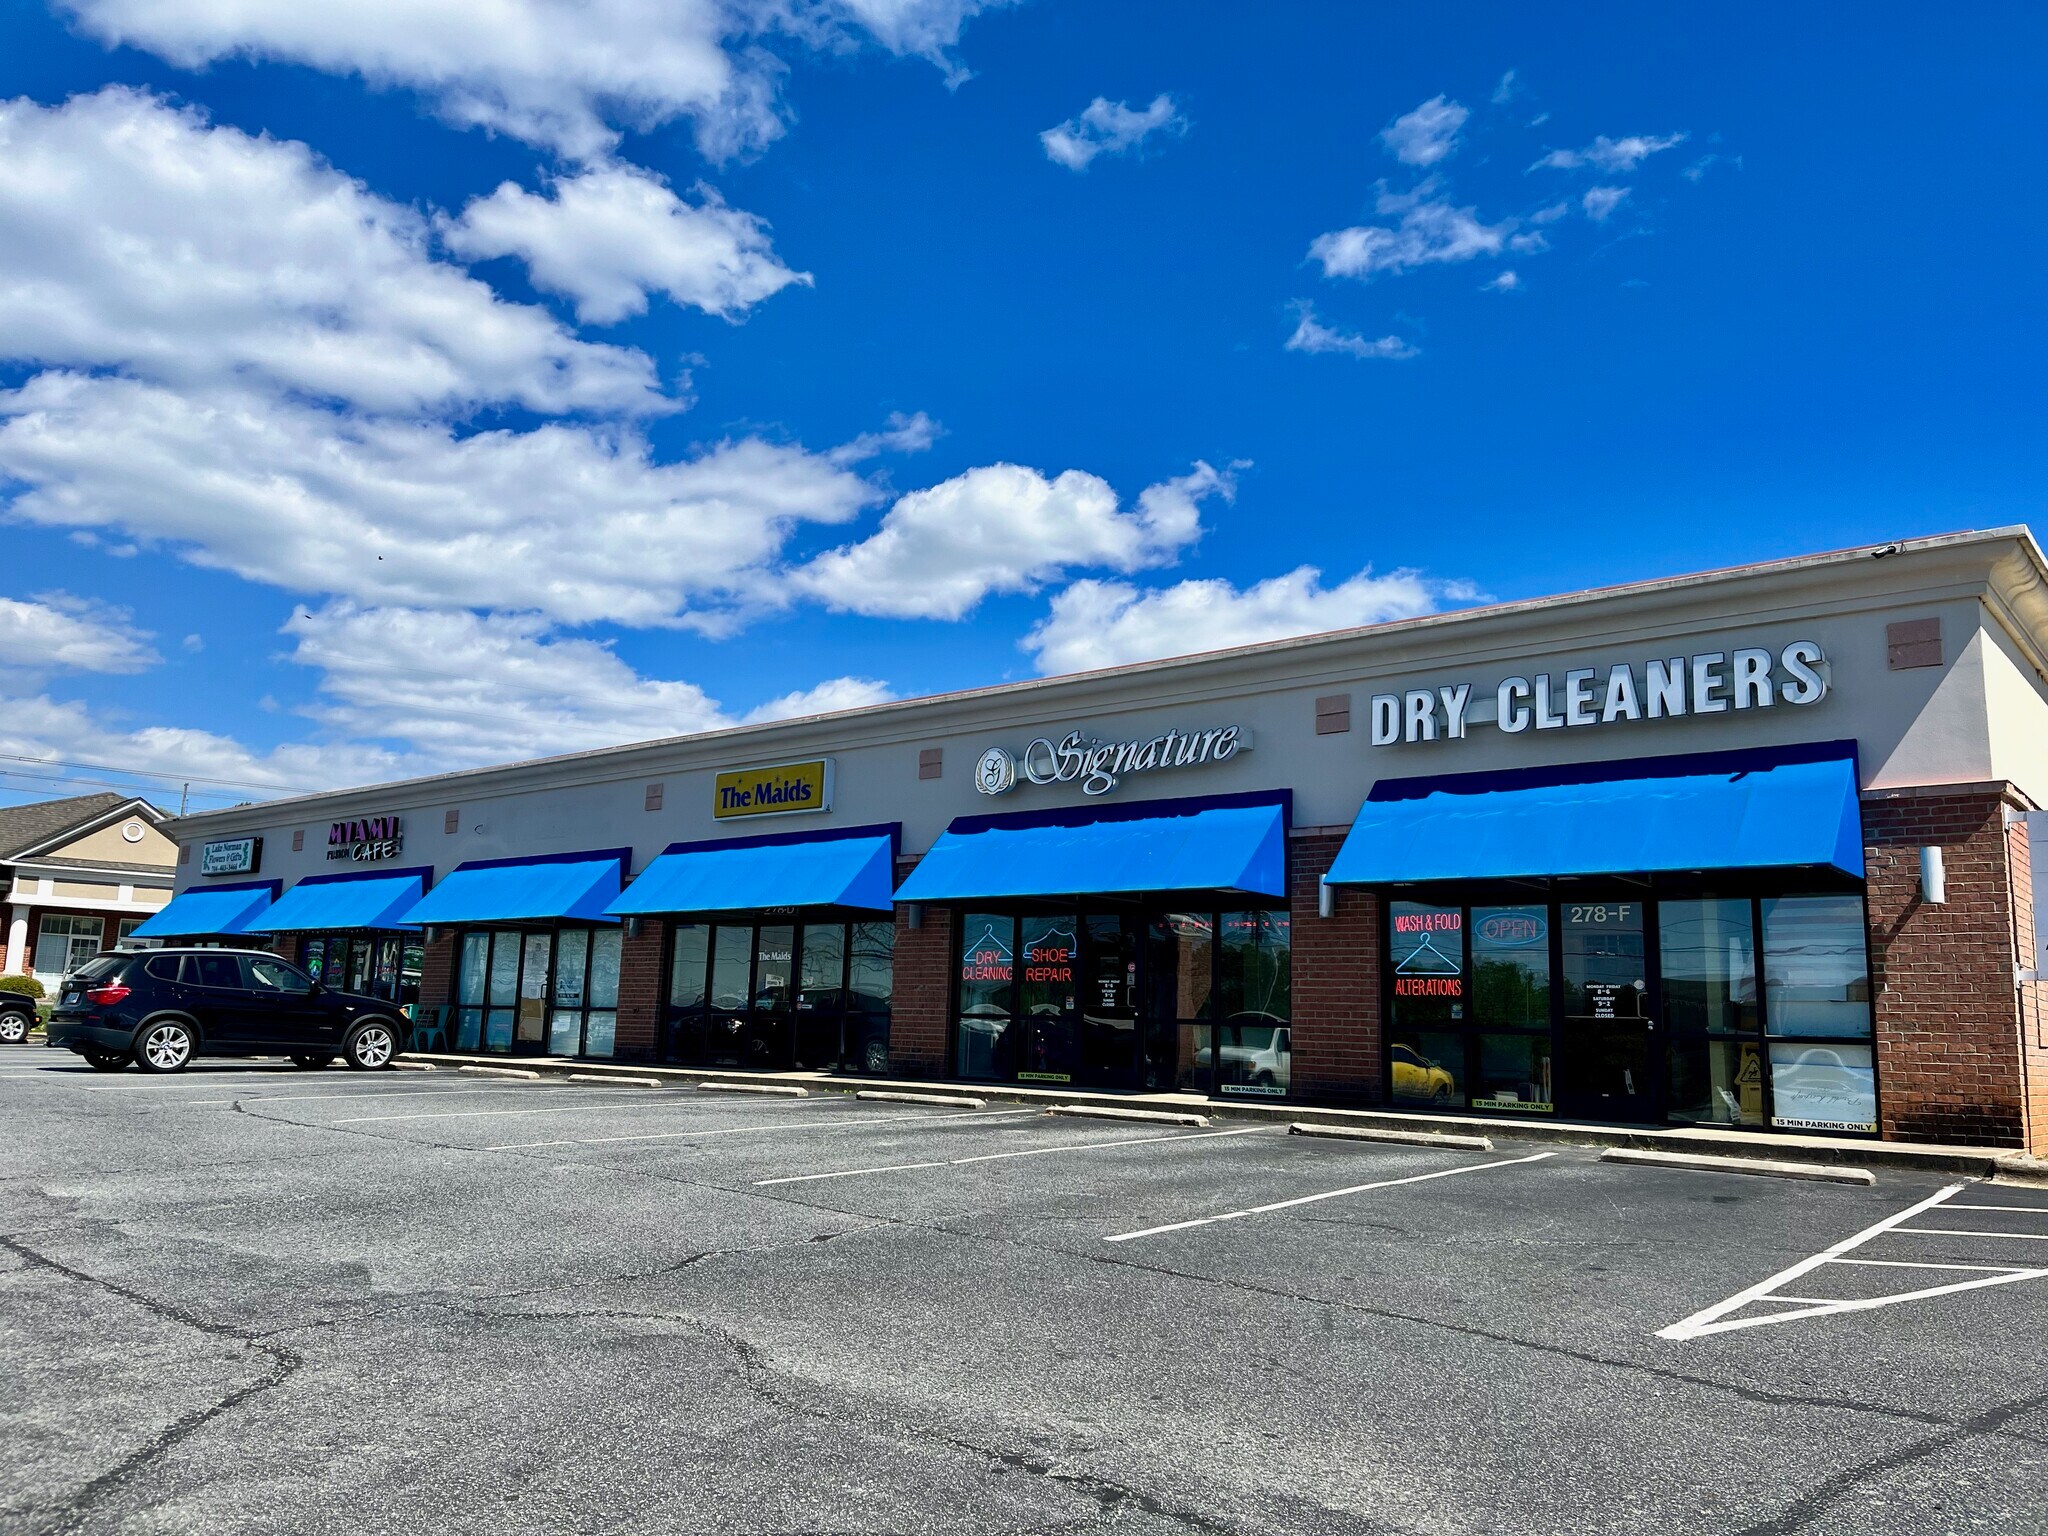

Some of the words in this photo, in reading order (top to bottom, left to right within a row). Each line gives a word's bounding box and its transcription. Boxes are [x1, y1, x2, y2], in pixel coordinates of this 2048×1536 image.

[1371, 683, 1471, 746] DRY
[1497, 640, 1827, 734] CLEANERS
[1024, 725, 1240, 796] Signature
[721, 786, 752, 809] The
[754, 779, 812, 806] Maids
[328, 816, 399, 845] MIAMI
[212, 844, 223, 853] Lake
[223, 843, 242, 851] Norman
[352, 840, 393, 861] CAFE
[209, 855, 226, 864] Flowers
[231, 852, 242, 862] Gifts
[1395, 915, 1423, 932] WASH
[1425, 913, 1434, 932] &
[1435, 913, 1461, 930] FOLD
[1571, 905, 1631, 923] 278-F
[1485, 919, 1537, 938] OPEN
[759, 952, 771, 960] The
[771, 951, 791, 960] Maids
[975, 951, 1001, 965] DRY
[1031, 948, 1069, 962] SHOE
[1026, 968, 1072, 981] REPAIR
[1395, 979, 1462, 996] ALTERATIONS
[1787, 1119, 1803, 1127] MIN
[1805, 1120, 1845, 1130] PARKING
[1847, 1123, 1872, 1131] ONLY
